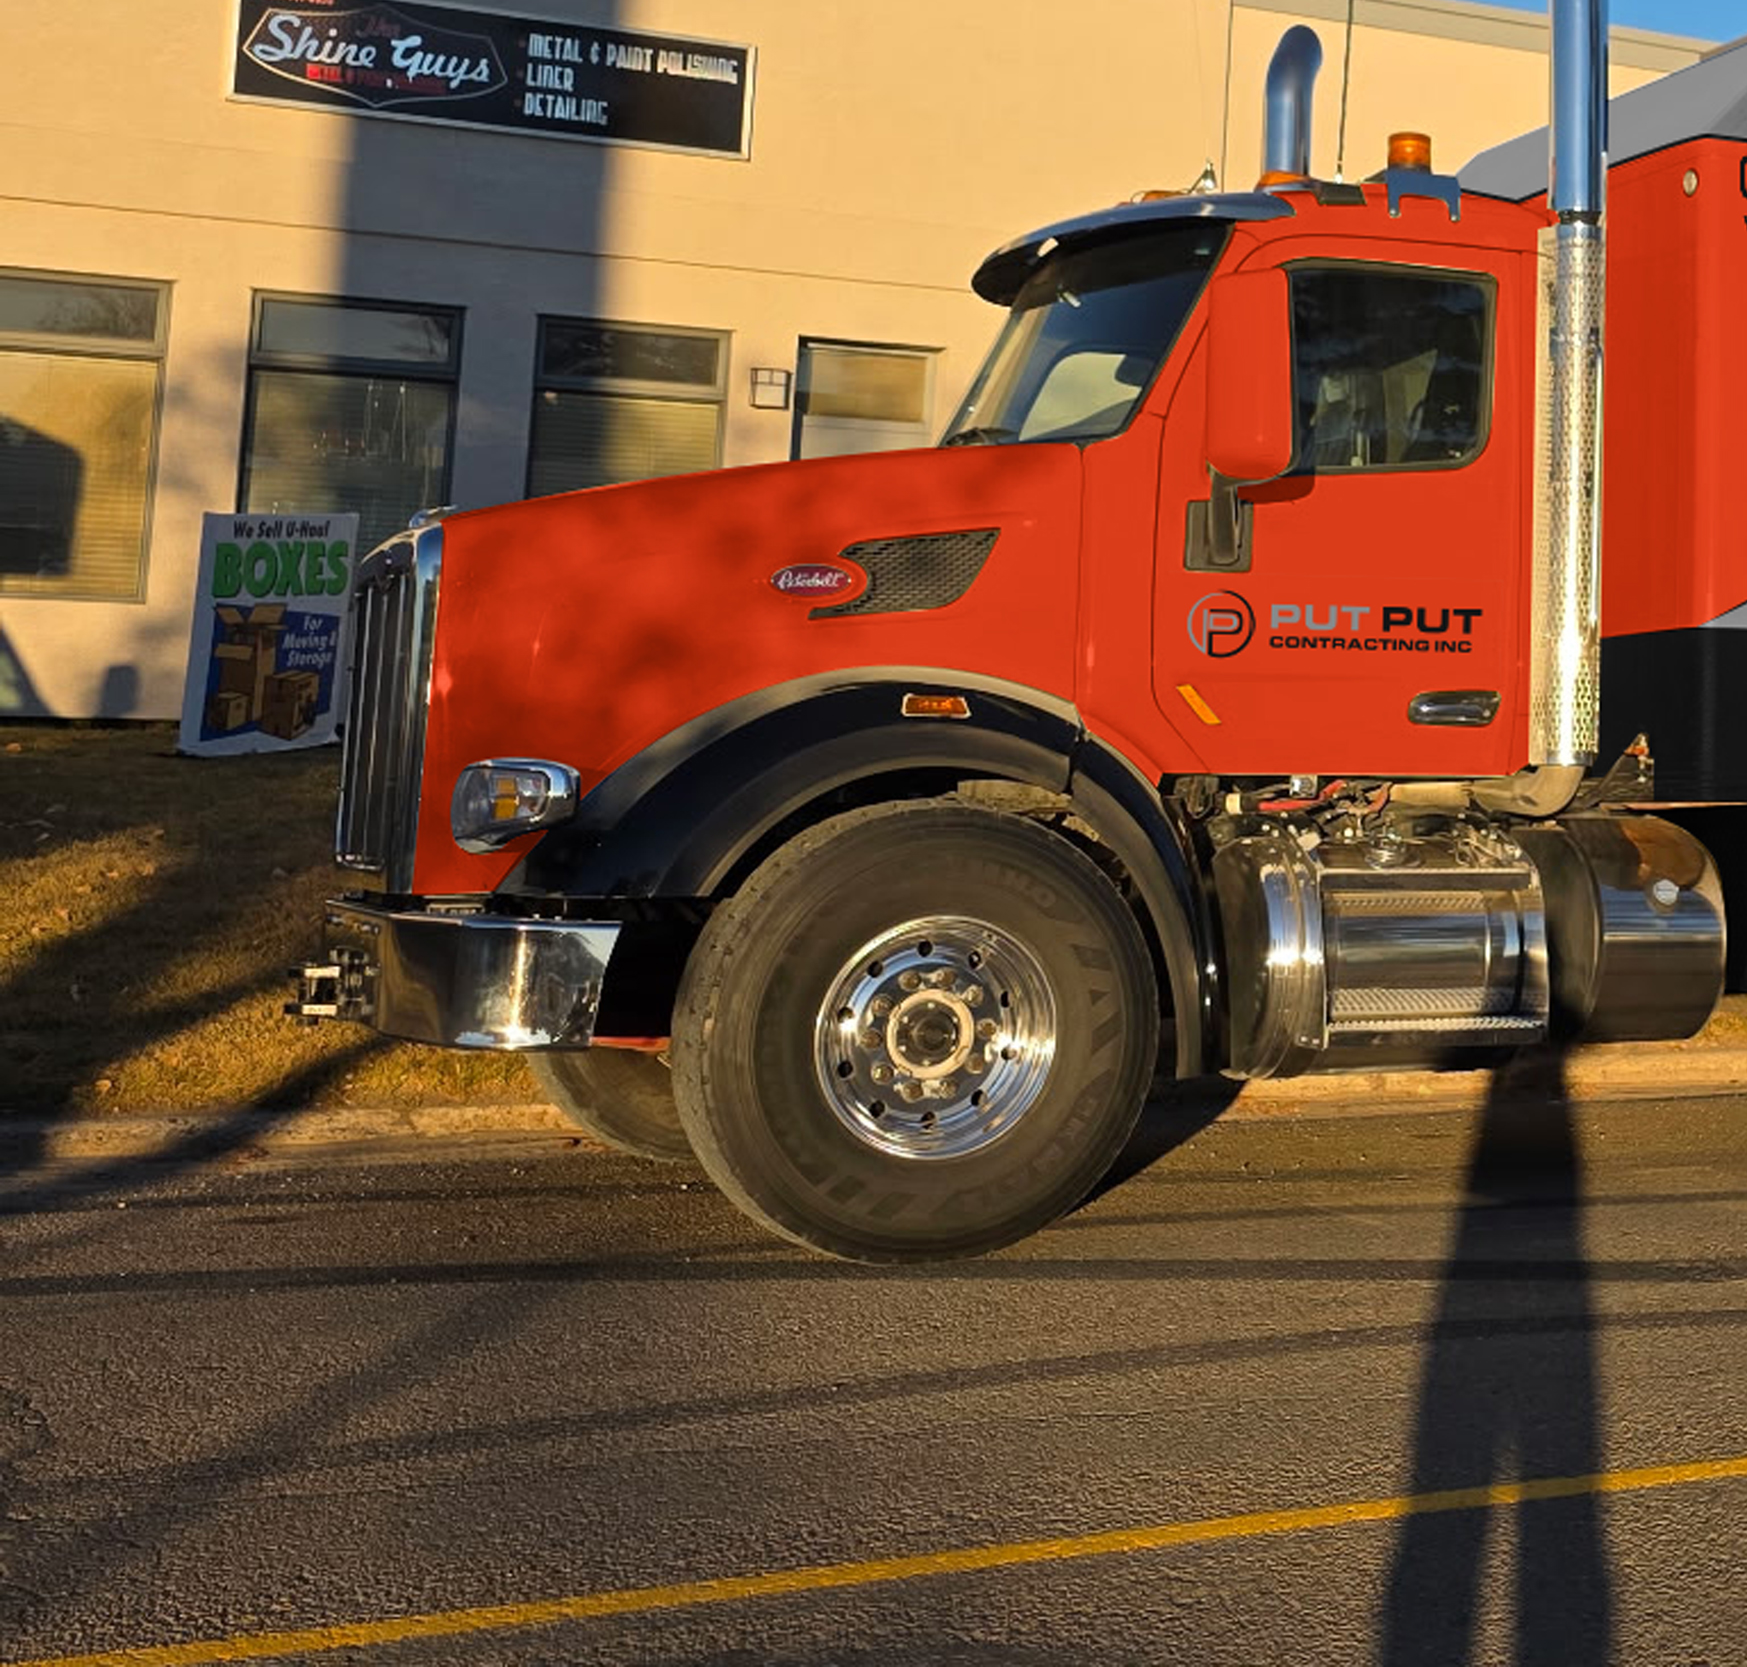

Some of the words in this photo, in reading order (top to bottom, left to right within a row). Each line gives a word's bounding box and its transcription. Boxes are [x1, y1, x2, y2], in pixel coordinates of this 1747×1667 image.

[252, 15, 376, 68] Shine
[391, 36, 490, 90] Guys
[528, 33, 583, 63] METAL
[606, 42, 654, 72] PAINT
[524, 92, 608, 126] DETAILING
[234, 521, 254, 539] We
[257, 521, 282, 538] Sell
[286, 520, 330, 539] U-Haul
[212, 540, 348, 598] BOXES
[303, 617, 322, 630] For
[1271, 604, 1370, 631] PUT
[1382, 606, 1483, 634] PUT
[1269, 636, 1430, 652] CONTRACTING
[1434, 639, 1473, 654] INC
